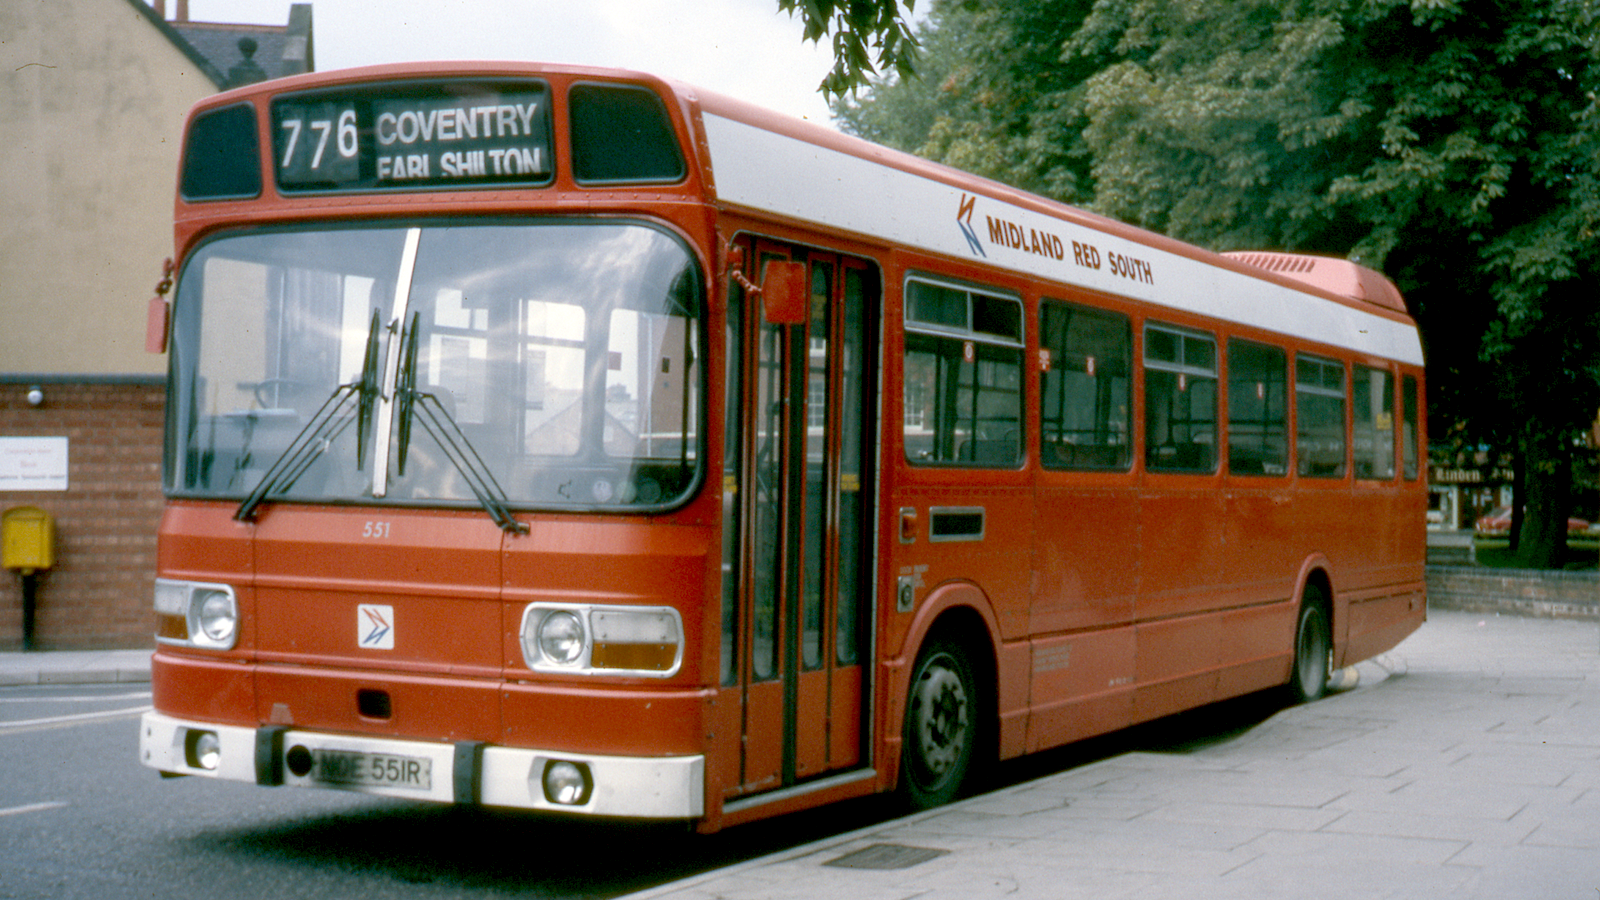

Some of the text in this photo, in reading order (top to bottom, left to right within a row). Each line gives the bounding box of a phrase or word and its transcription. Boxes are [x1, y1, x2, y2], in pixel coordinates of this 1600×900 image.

[281, 109, 358, 169] 776
[376, 103, 537, 145] COVENTRY
[986, 214, 1154, 285] MIDLAND RED SOUTH
[362, 521, 391, 538] 551
[371, 758, 420, 784] 551R
